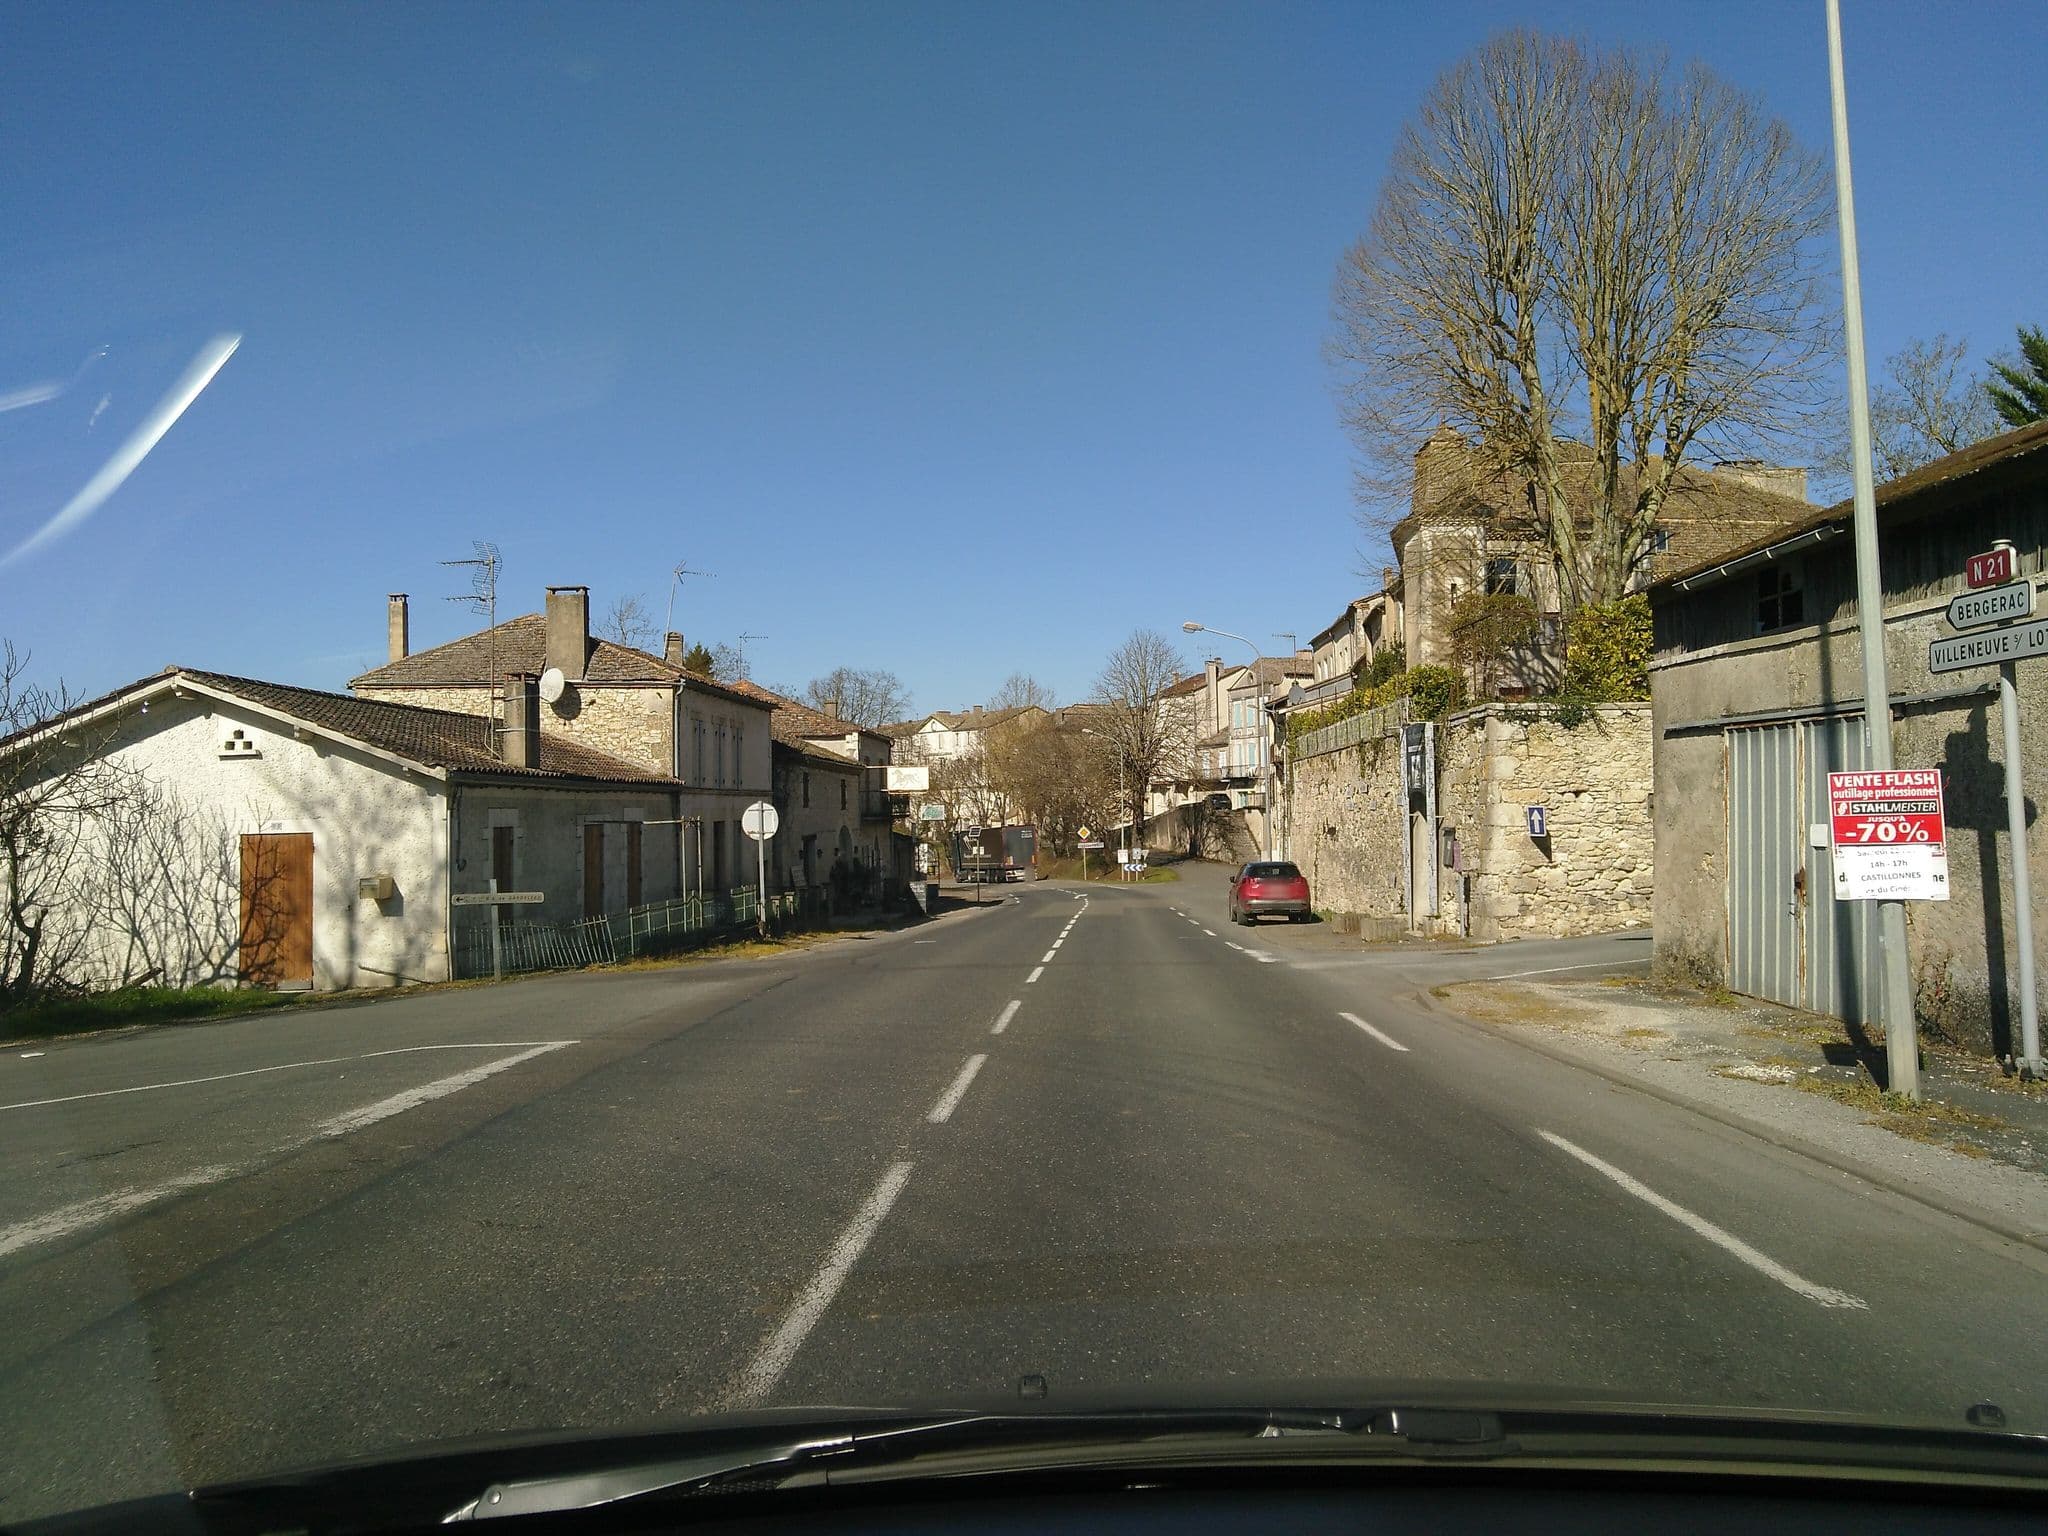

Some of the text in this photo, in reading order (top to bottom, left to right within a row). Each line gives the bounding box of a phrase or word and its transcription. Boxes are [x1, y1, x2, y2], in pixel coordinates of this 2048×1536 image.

[1973, 555, 2004, 582] N 21
[1957, 592, 2024, 621] BERGERAC
[1934, 636, 2009, 665] VILLENEUVE
[1832, 773, 1935, 788] VENTE FLASH
[1833, 785, 1938, 800] outillage professionnel
[1852, 801, 1936, 813] STAHLMEISTER
